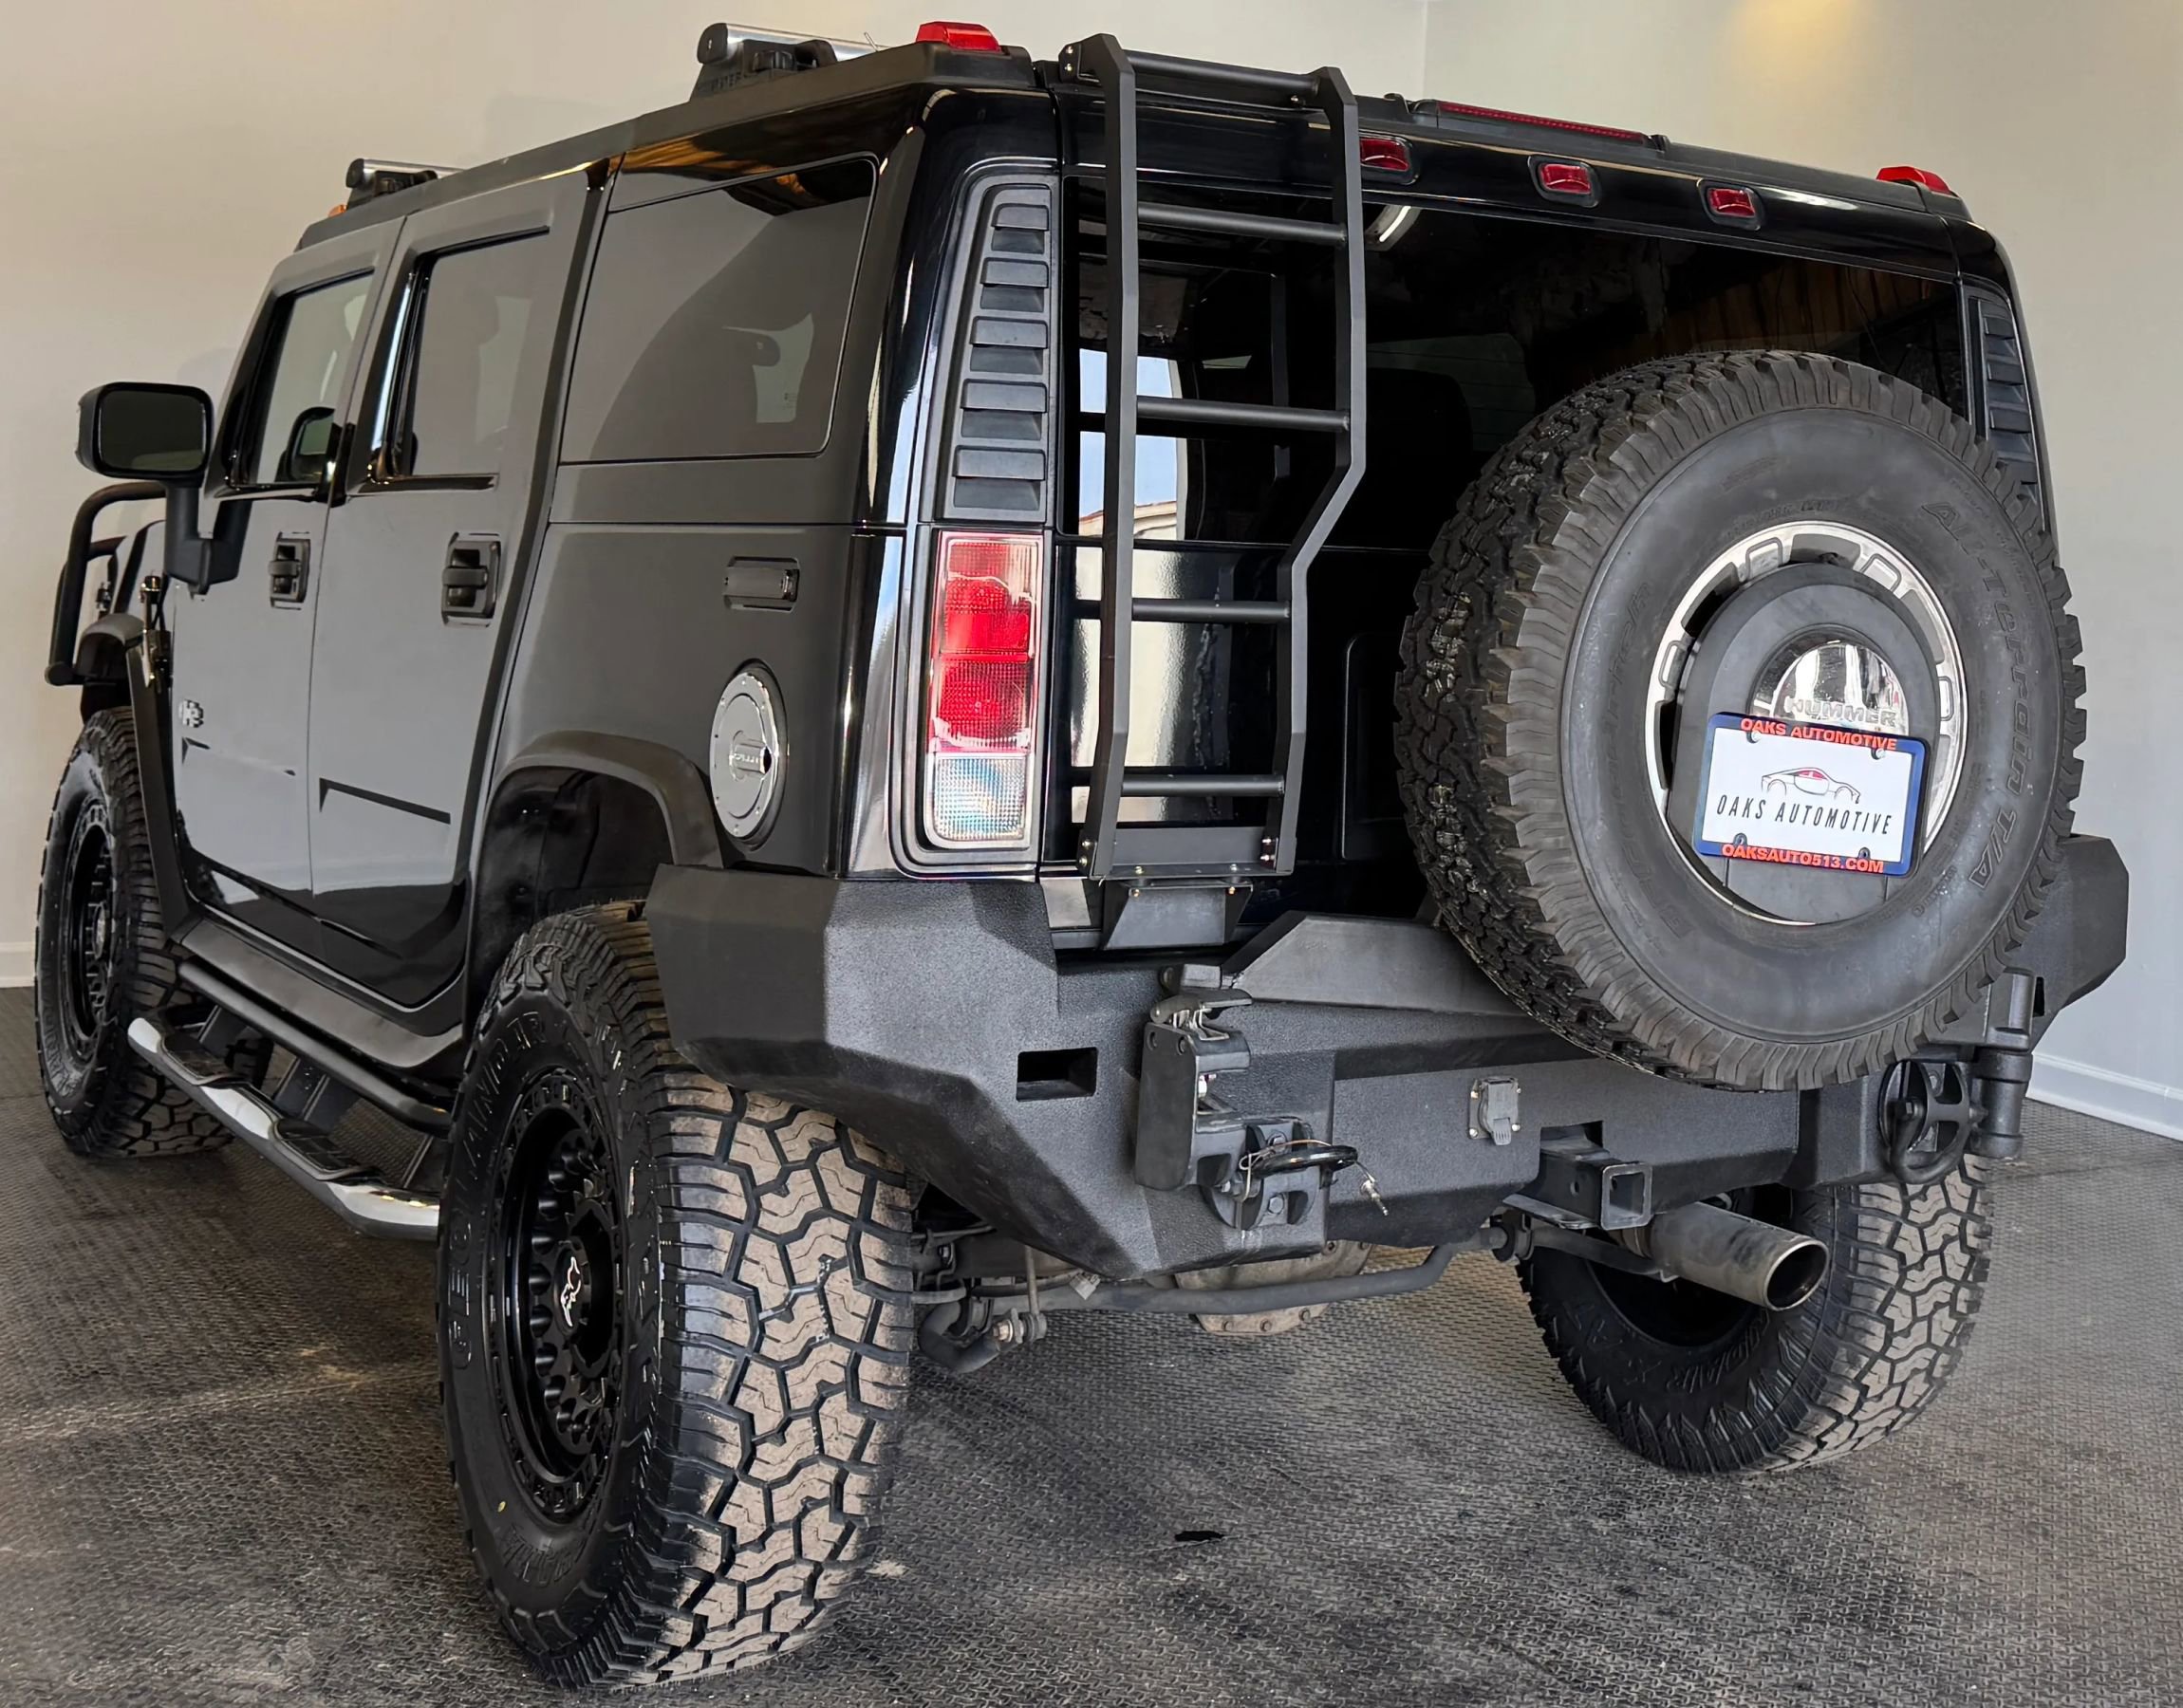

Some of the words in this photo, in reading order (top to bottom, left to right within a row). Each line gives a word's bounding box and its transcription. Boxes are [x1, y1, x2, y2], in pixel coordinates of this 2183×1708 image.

[1739, 717, 1787, 737] OAKS
[1790, 726, 1897, 751] AUTOMOTIVE
[1716, 794, 1767, 820] OAKS
[1775, 802, 1893, 835] AUTOMOTIVE
[1722, 844, 1885, 874] OAKSAUTO513.COM
[1968, 808, 2018, 889] T/A
